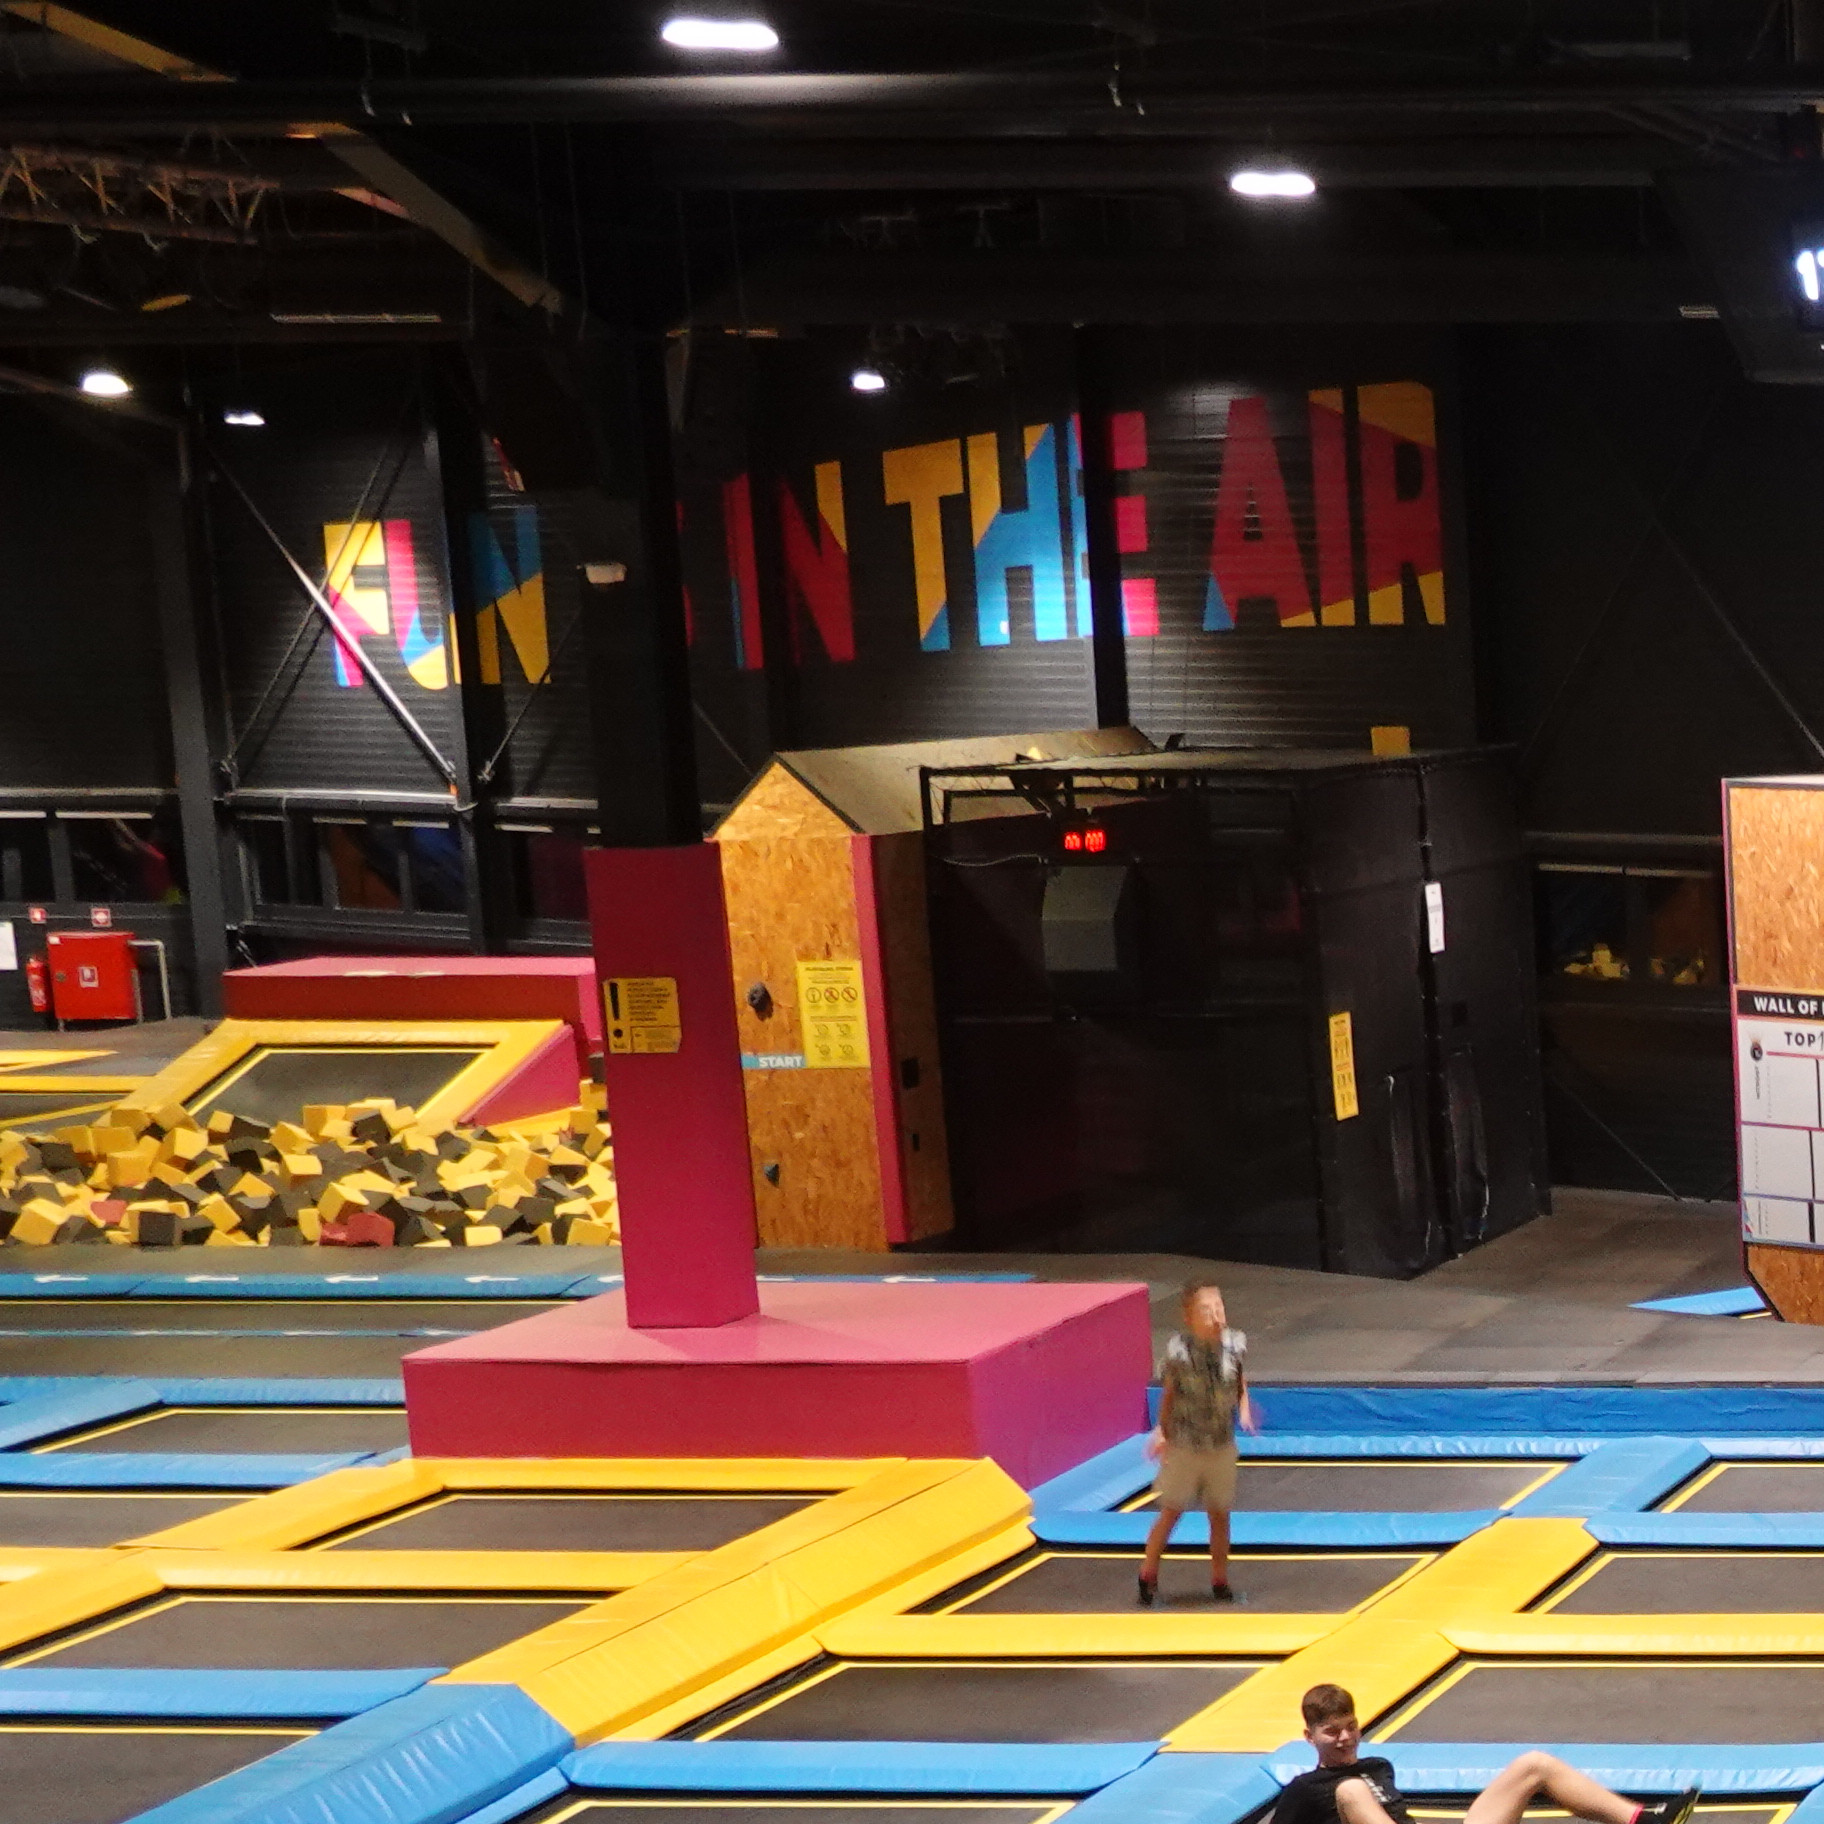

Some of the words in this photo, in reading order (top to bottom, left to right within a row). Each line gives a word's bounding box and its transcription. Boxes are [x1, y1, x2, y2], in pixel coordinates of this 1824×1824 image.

[323, 506, 552, 690] FUN
[722, 461, 857, 670] IN
[882, 411, 1159, 651] THE
[1203, 380, 1446, 631] AIR
[1754, 996, 1795, 1014] WALL
[1798, 1000, 1818, 1015] OF
[1784, 1031, 1815, 1048] TOP
[759, 1055, 803, 1068] START
